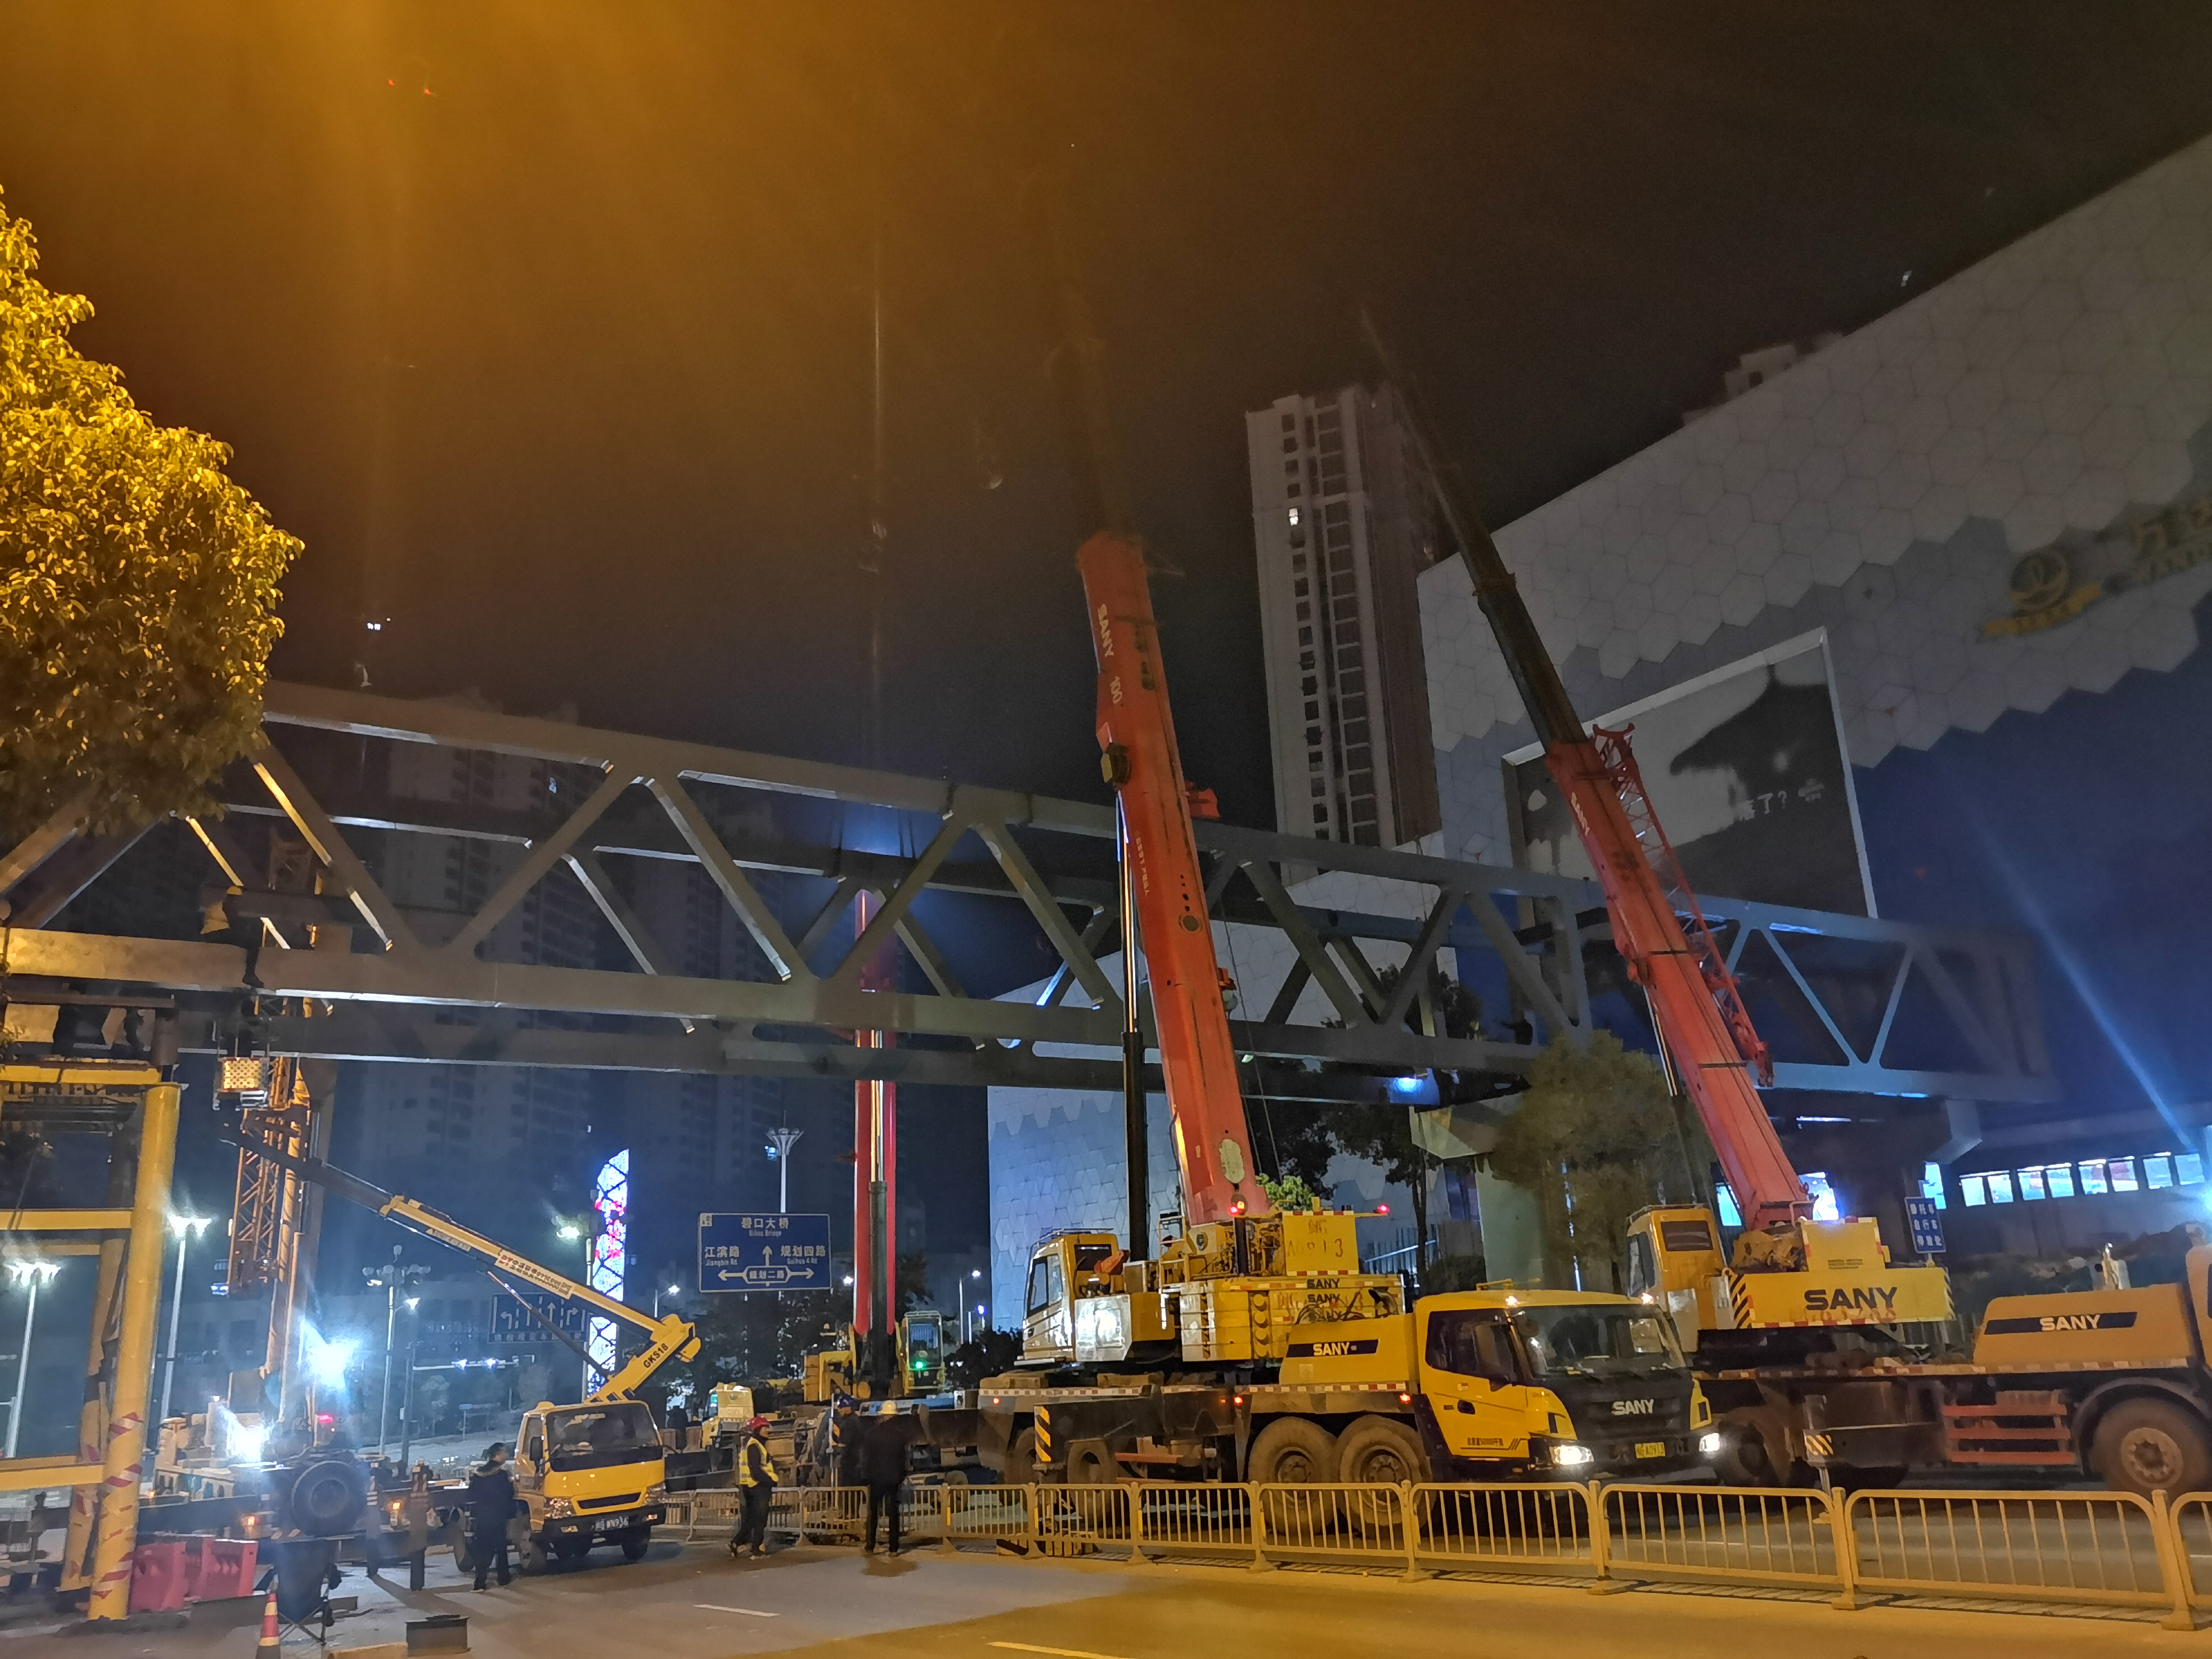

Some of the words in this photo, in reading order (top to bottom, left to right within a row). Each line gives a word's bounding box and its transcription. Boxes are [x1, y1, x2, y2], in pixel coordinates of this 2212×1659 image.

[1307, 1278, 1340, 1289] SANY
[1804, 1287, 1898, 1310] SANY
[2040, 1314, 2101, 1331] SANY
[643, 1343, 669, 1368] GKS18
[1313, 1342, 1350, 1356] SANY
[1612, 1399, 1654, 1415] SANY
